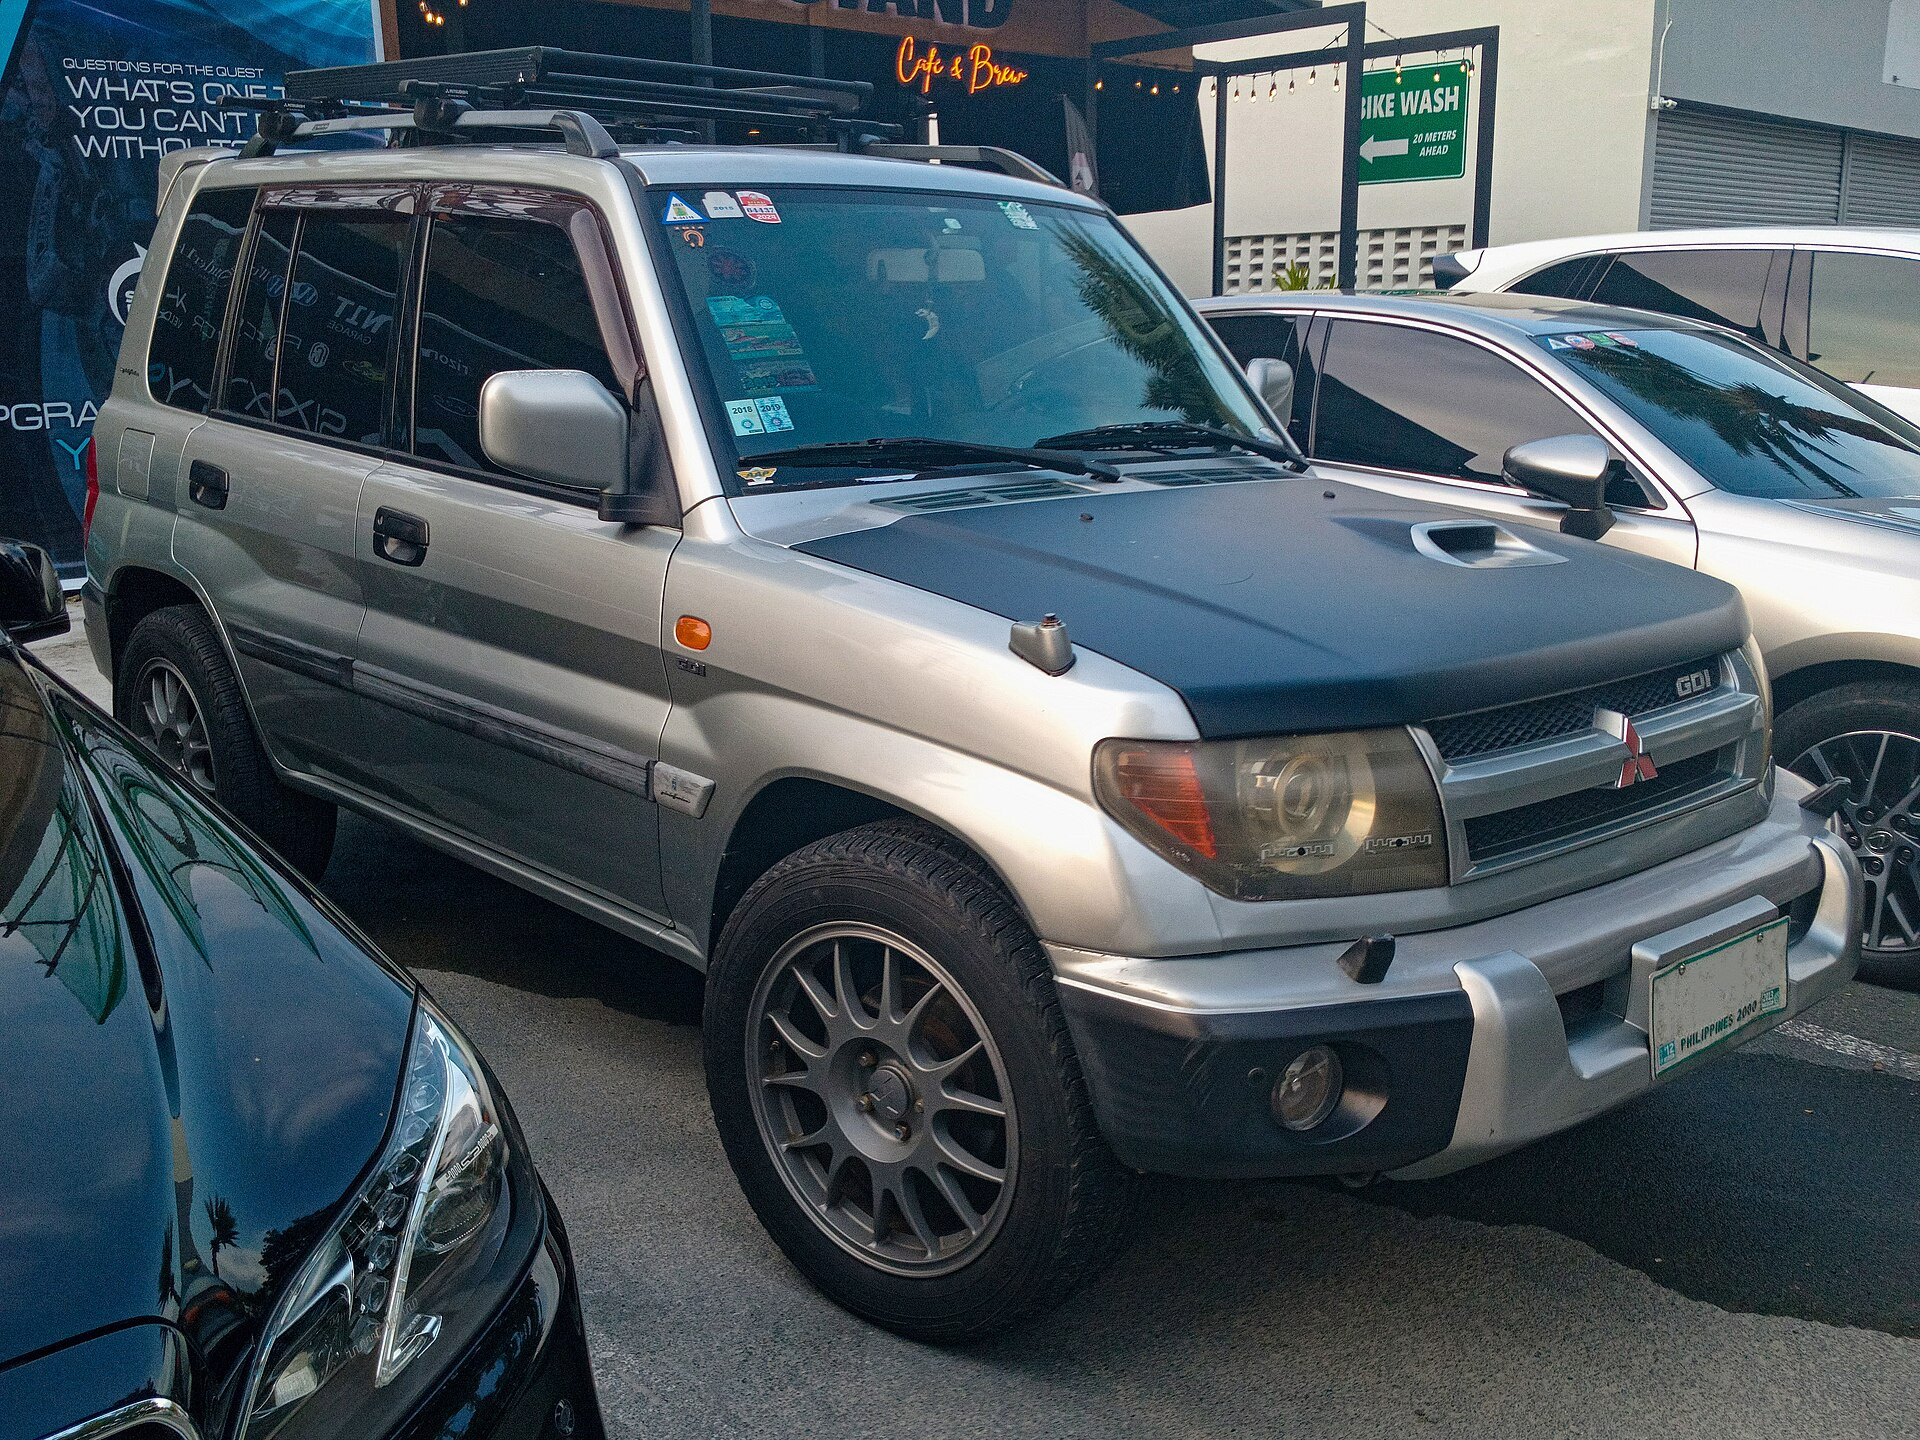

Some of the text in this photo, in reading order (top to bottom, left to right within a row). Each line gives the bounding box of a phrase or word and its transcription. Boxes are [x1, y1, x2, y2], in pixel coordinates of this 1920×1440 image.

[62, 57, 264, 79] QUESTIONS FOR THE QUEST
[950, 56, 964, 80] &
[969, 42, 1029, 94] Brew
[64, 75, 196, 104] WHAT'S
[1400, 85, 1460, 116] WASH
[68, 104, 146, 130] YOU
[153, 109, 248, 134] CAN'T
[1412, 130, 1457, 145] 20 METERS
[1419, 145, 1449, 157] AHEAD
[731, 403, 781, 415] 2018 2019
[1676, 669, 1711, 697] GDI
[1680, 1013, 1734, 1051] PHILIPPINES
